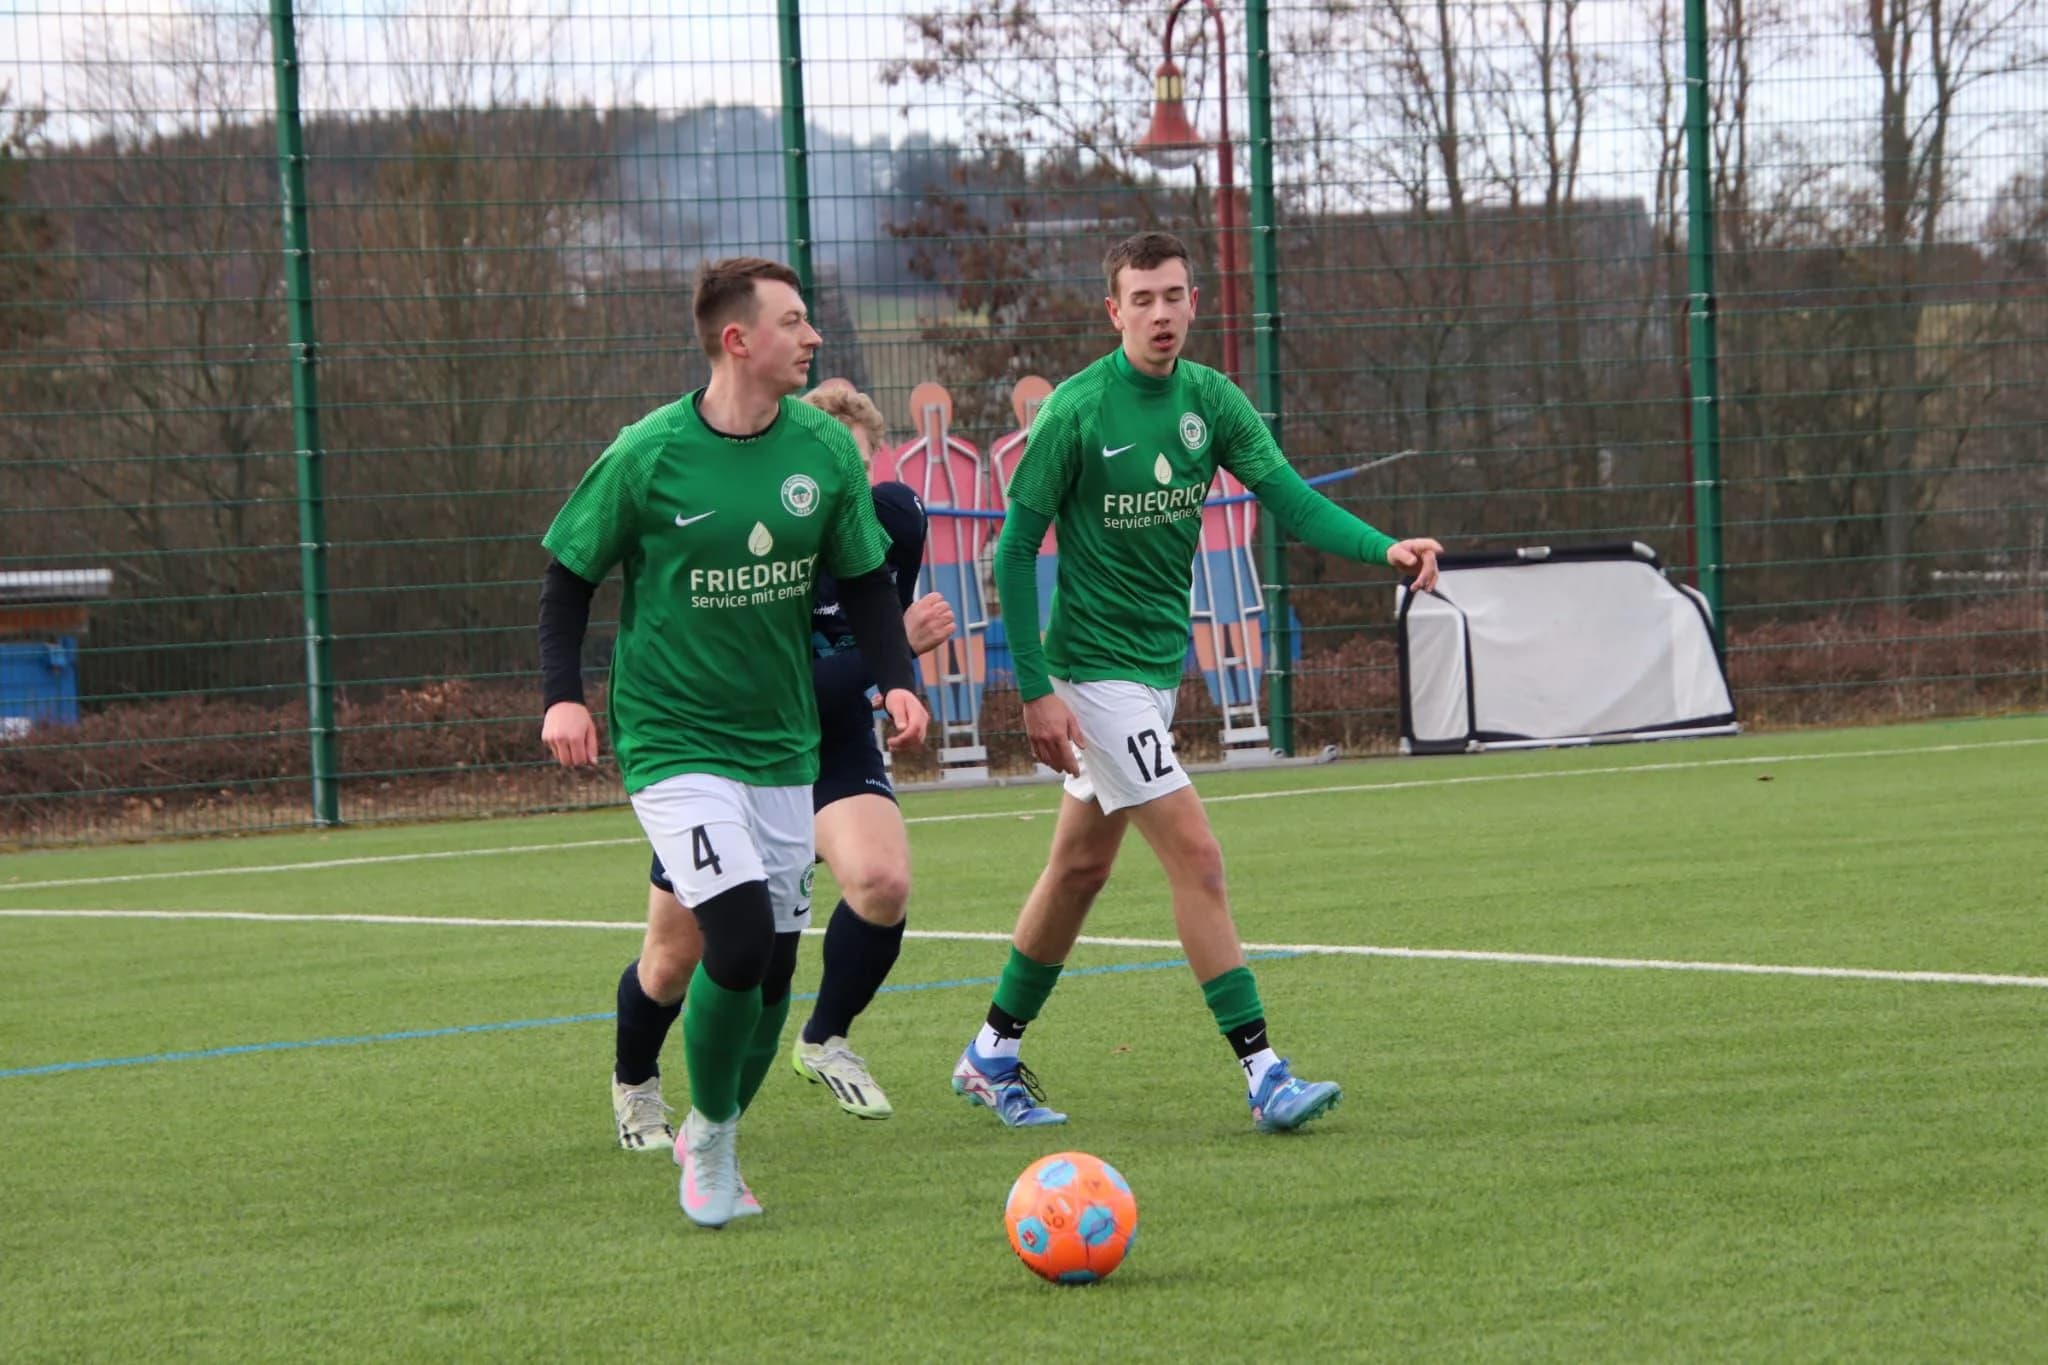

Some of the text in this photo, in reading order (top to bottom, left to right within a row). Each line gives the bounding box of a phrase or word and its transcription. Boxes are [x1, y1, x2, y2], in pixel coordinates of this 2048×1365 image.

[1103, 513, 1150, 529] service
[691, 592, 747, 609] service
[751, 588, 776, 606] mit
[1127, 728, 1174, 783] 12
[691, 823, 723, 876] 4
